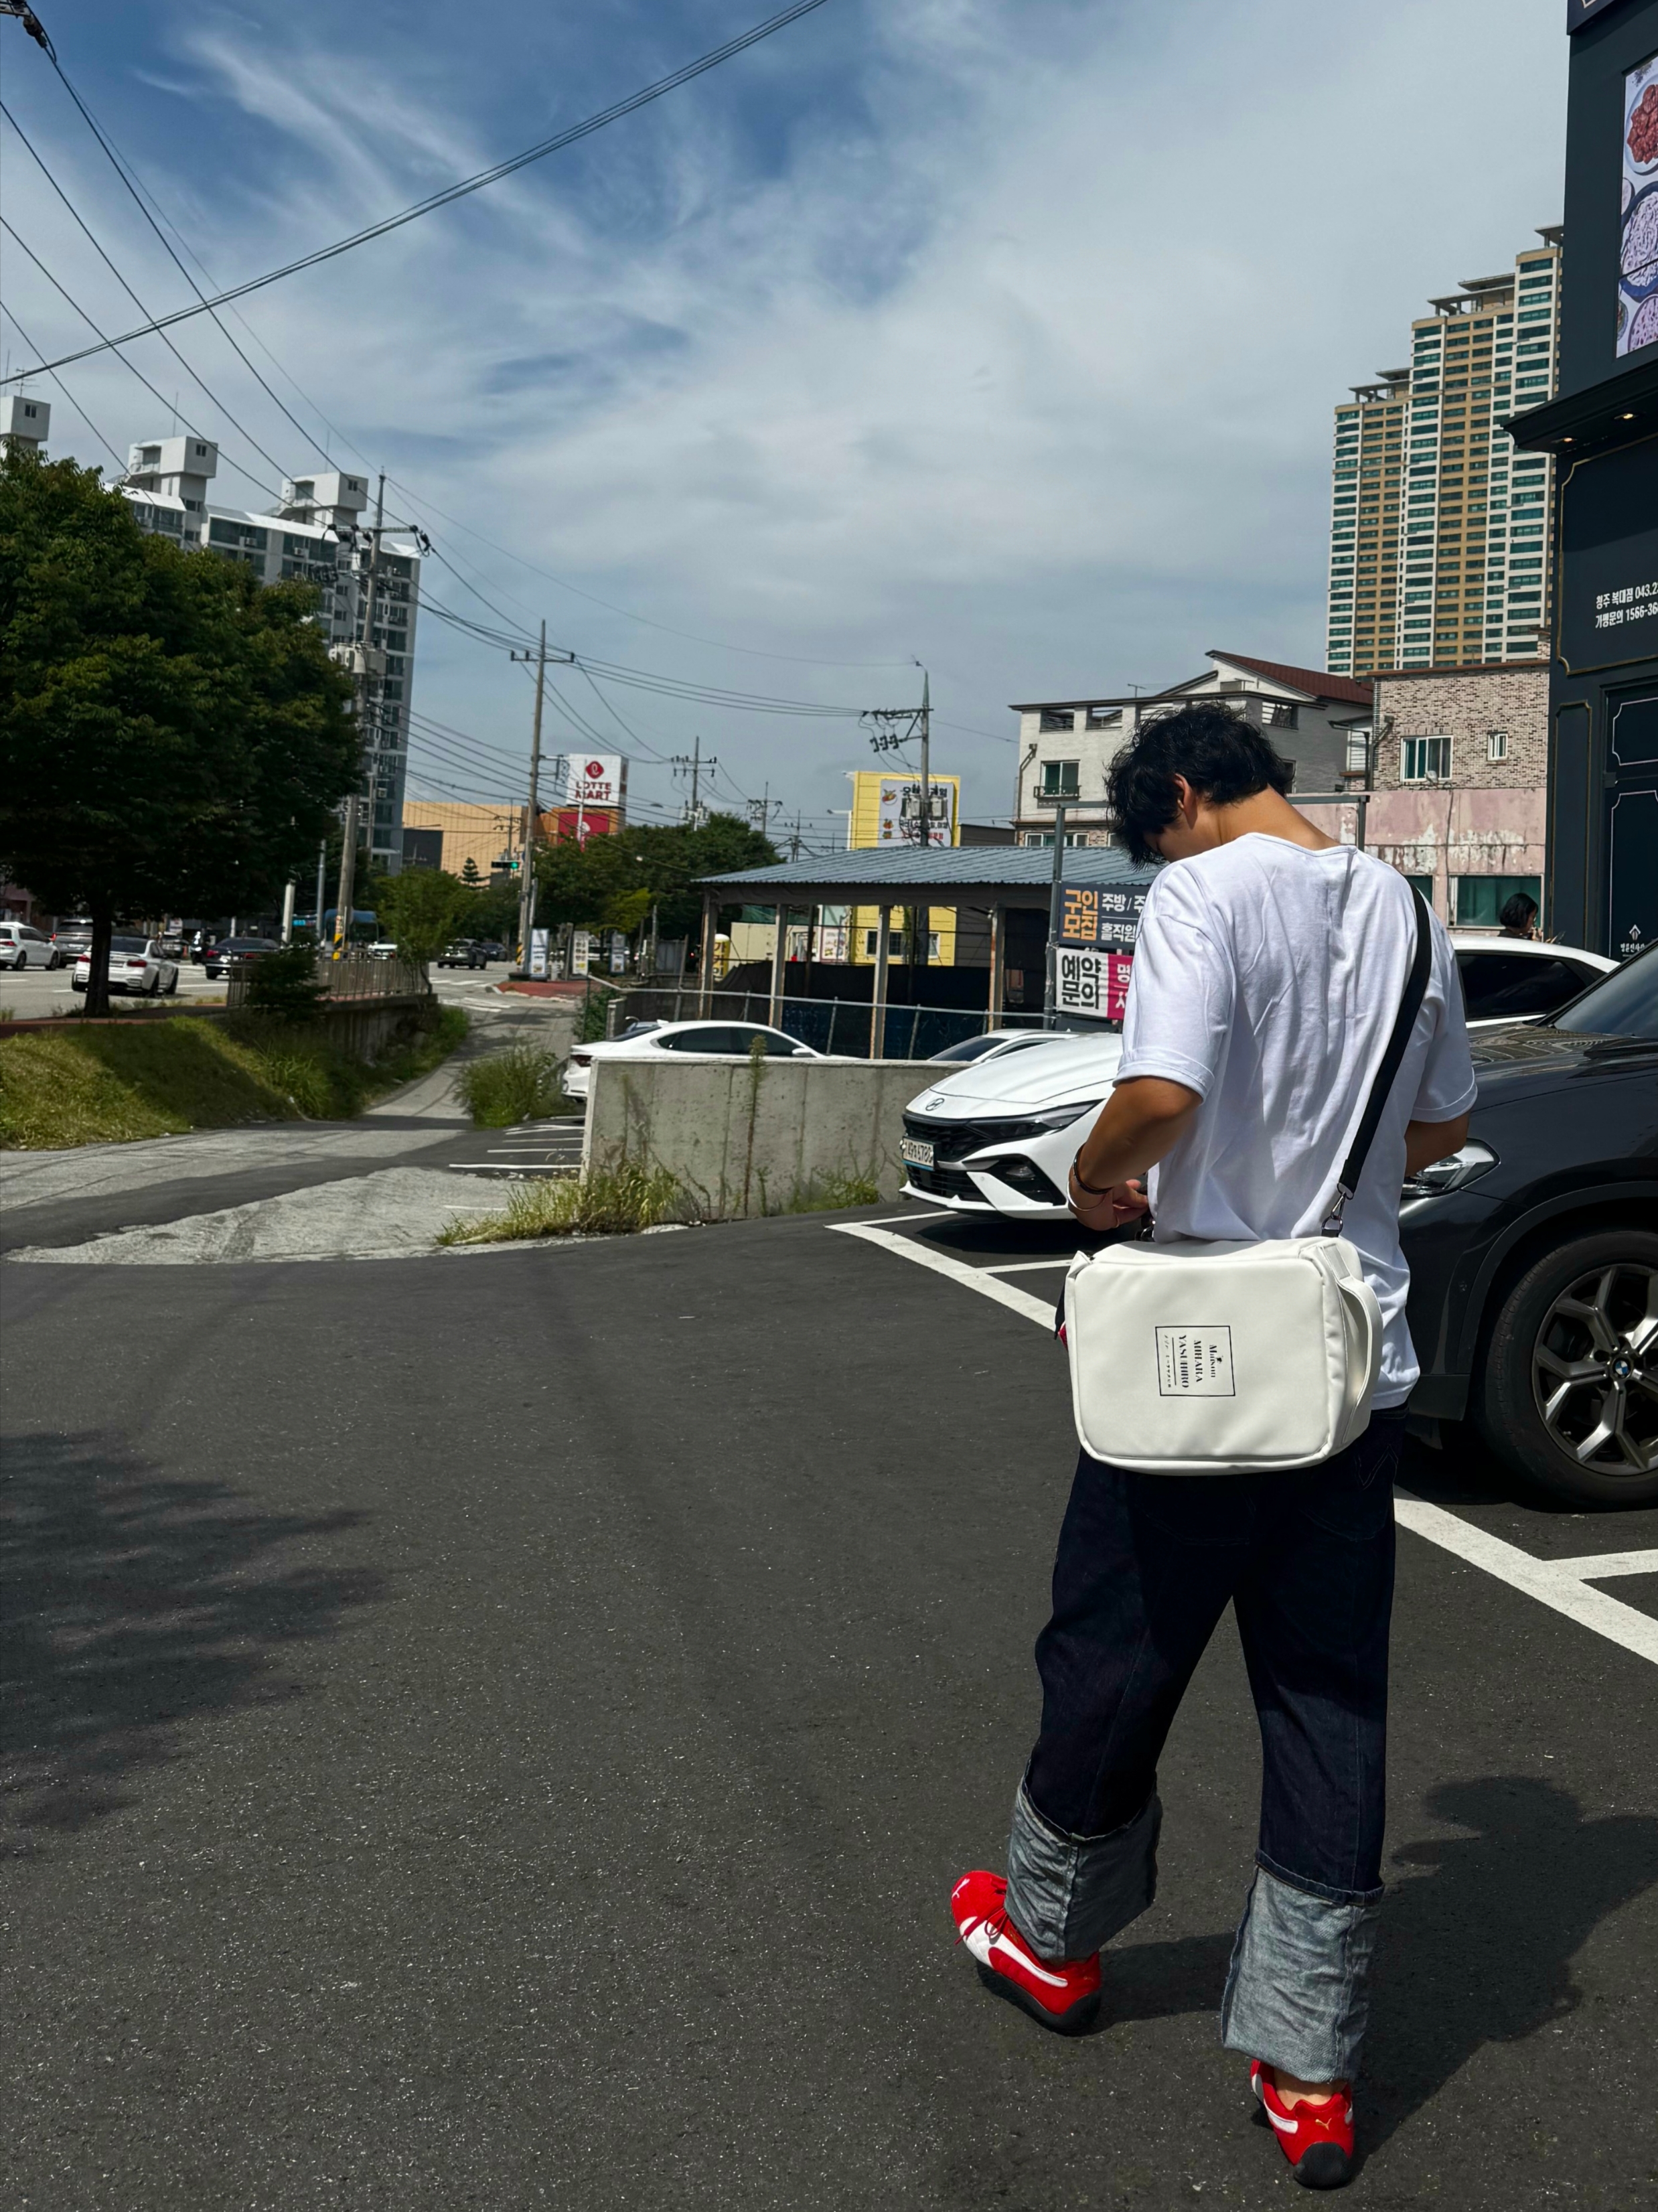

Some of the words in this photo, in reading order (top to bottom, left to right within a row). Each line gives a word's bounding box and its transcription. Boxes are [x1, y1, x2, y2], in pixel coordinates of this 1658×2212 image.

[1596, 593, 1610, 609] 청주
[1612, 587, 1633, 605] 복대점
[1635, 581, 1658, 599] 043.2
[1595, 609, 1624, 628] 가맹문의
[1625, 601, 1658, 621] 1566-36
[575, 781, 612, 790] LOTTE
[575, 790, 611, 801] MART
[1064, 889, 1098, 915] 구인
[1102, 893, 1126, 912] 주방
[1062, 913, 1098, 942] 모집
[1061, 954, 1102, 984] 예약
[1061, 980, 1099, 1010] 문의
[1179, 1335, 1189, 1388] YASUHIRO
[1193, 1339, 1203, 1382] MIHARA
